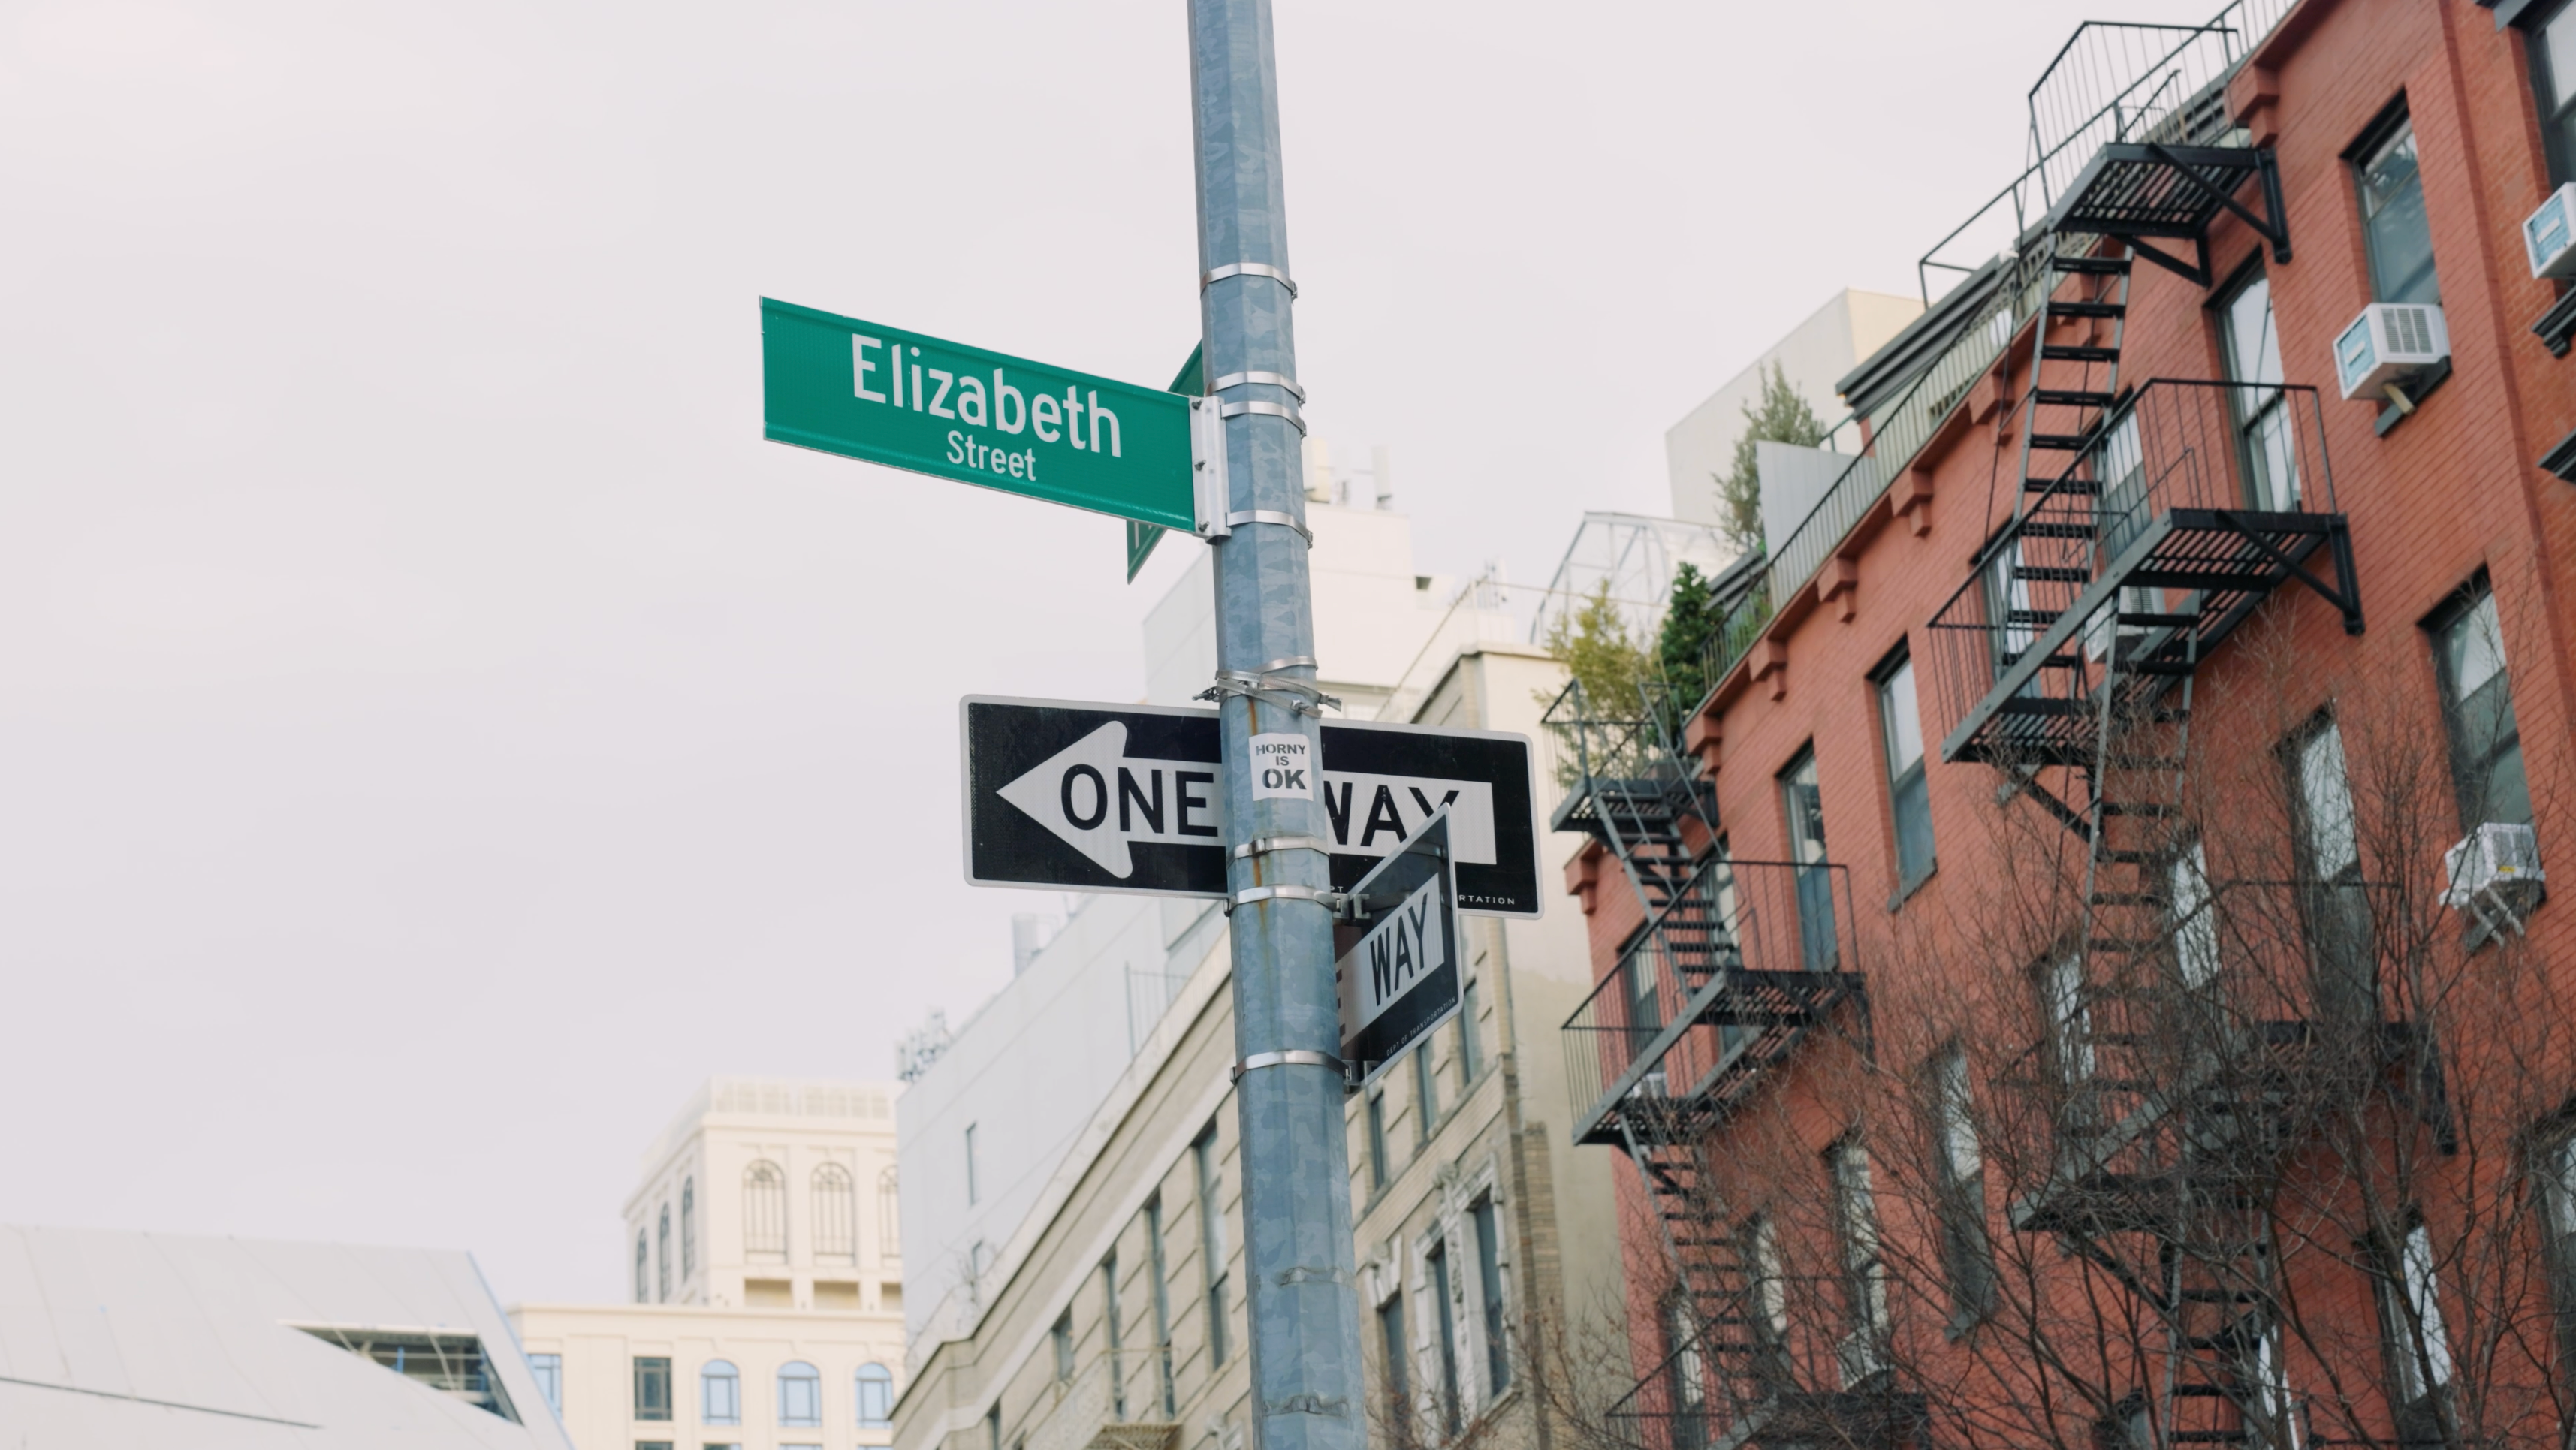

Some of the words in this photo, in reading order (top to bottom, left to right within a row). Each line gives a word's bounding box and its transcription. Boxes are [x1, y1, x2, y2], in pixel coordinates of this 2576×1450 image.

[852, 333, 1121, 458] Elizabeth
[946, 430, 1036, 481] Street
[1256, 743, 1306, 756] HORNY
[1275, 755, 1290, 767] IS
[1060, 764, 1219, 837] ONE
[1262, 768, 1307, 790] OK
[1370, 892, 1428, 1007] WAY
[1386, 1042, 1400, 1057] DEPT
[1401, 1034, 1408, 1045] OF
[1410, 996, 1456, 1037] TRANSPORTATION
